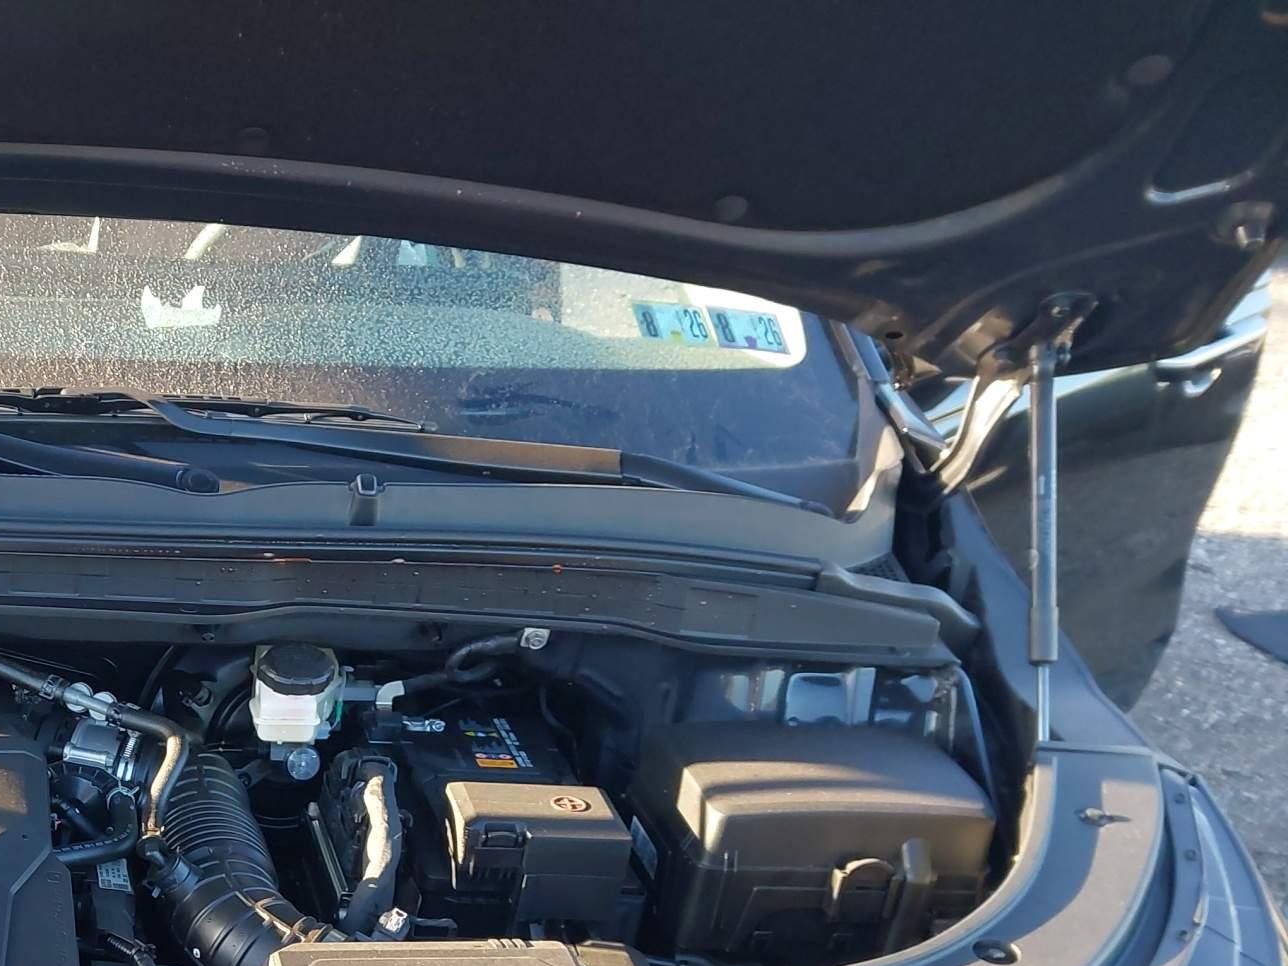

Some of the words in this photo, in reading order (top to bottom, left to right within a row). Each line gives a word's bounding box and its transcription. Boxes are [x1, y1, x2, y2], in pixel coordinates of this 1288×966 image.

[642, 311, 659, 338] 8
[683, 309, 708, 338] 26
[716, 313, 736, 343] 8
[758, 316, 782, 346] 26
